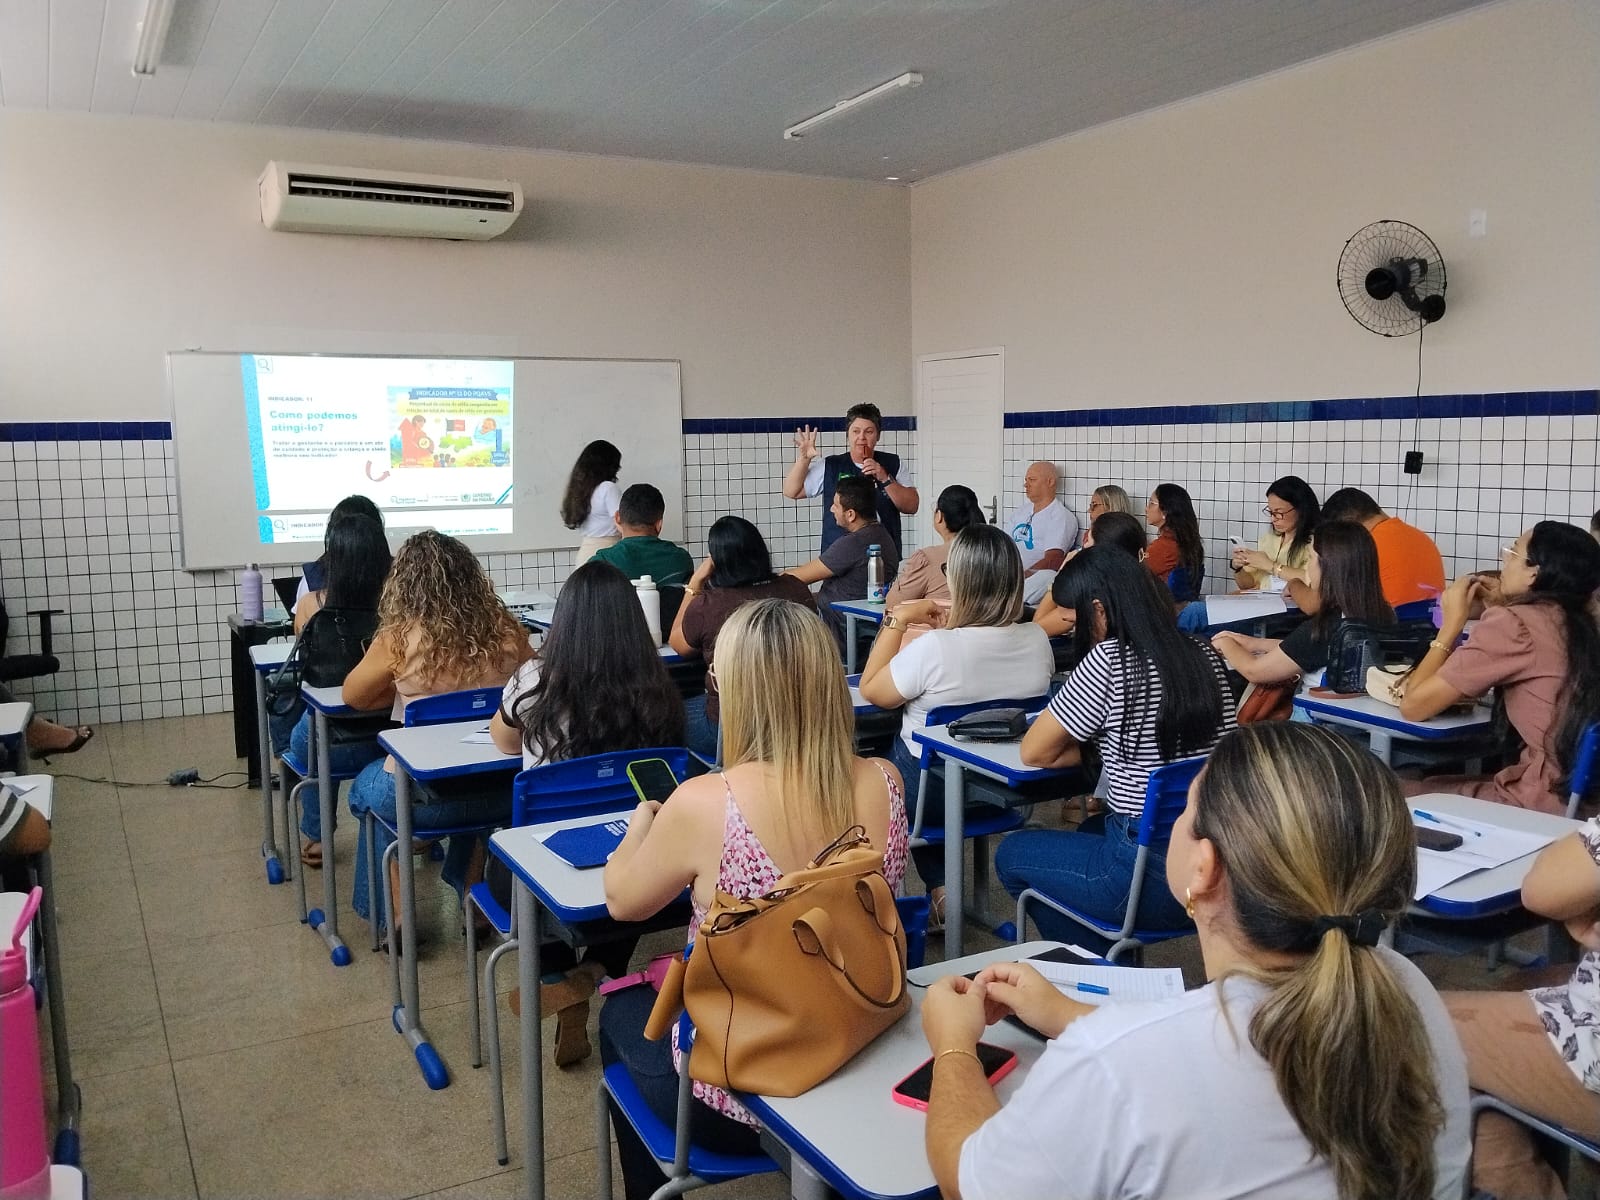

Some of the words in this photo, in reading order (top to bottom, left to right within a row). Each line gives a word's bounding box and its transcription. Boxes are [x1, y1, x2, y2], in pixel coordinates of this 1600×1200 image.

[270, 410, 303, 418] Como
[306, 412, 358, 420] podemos
[271, 424, 324, 434] atingi-lo?
